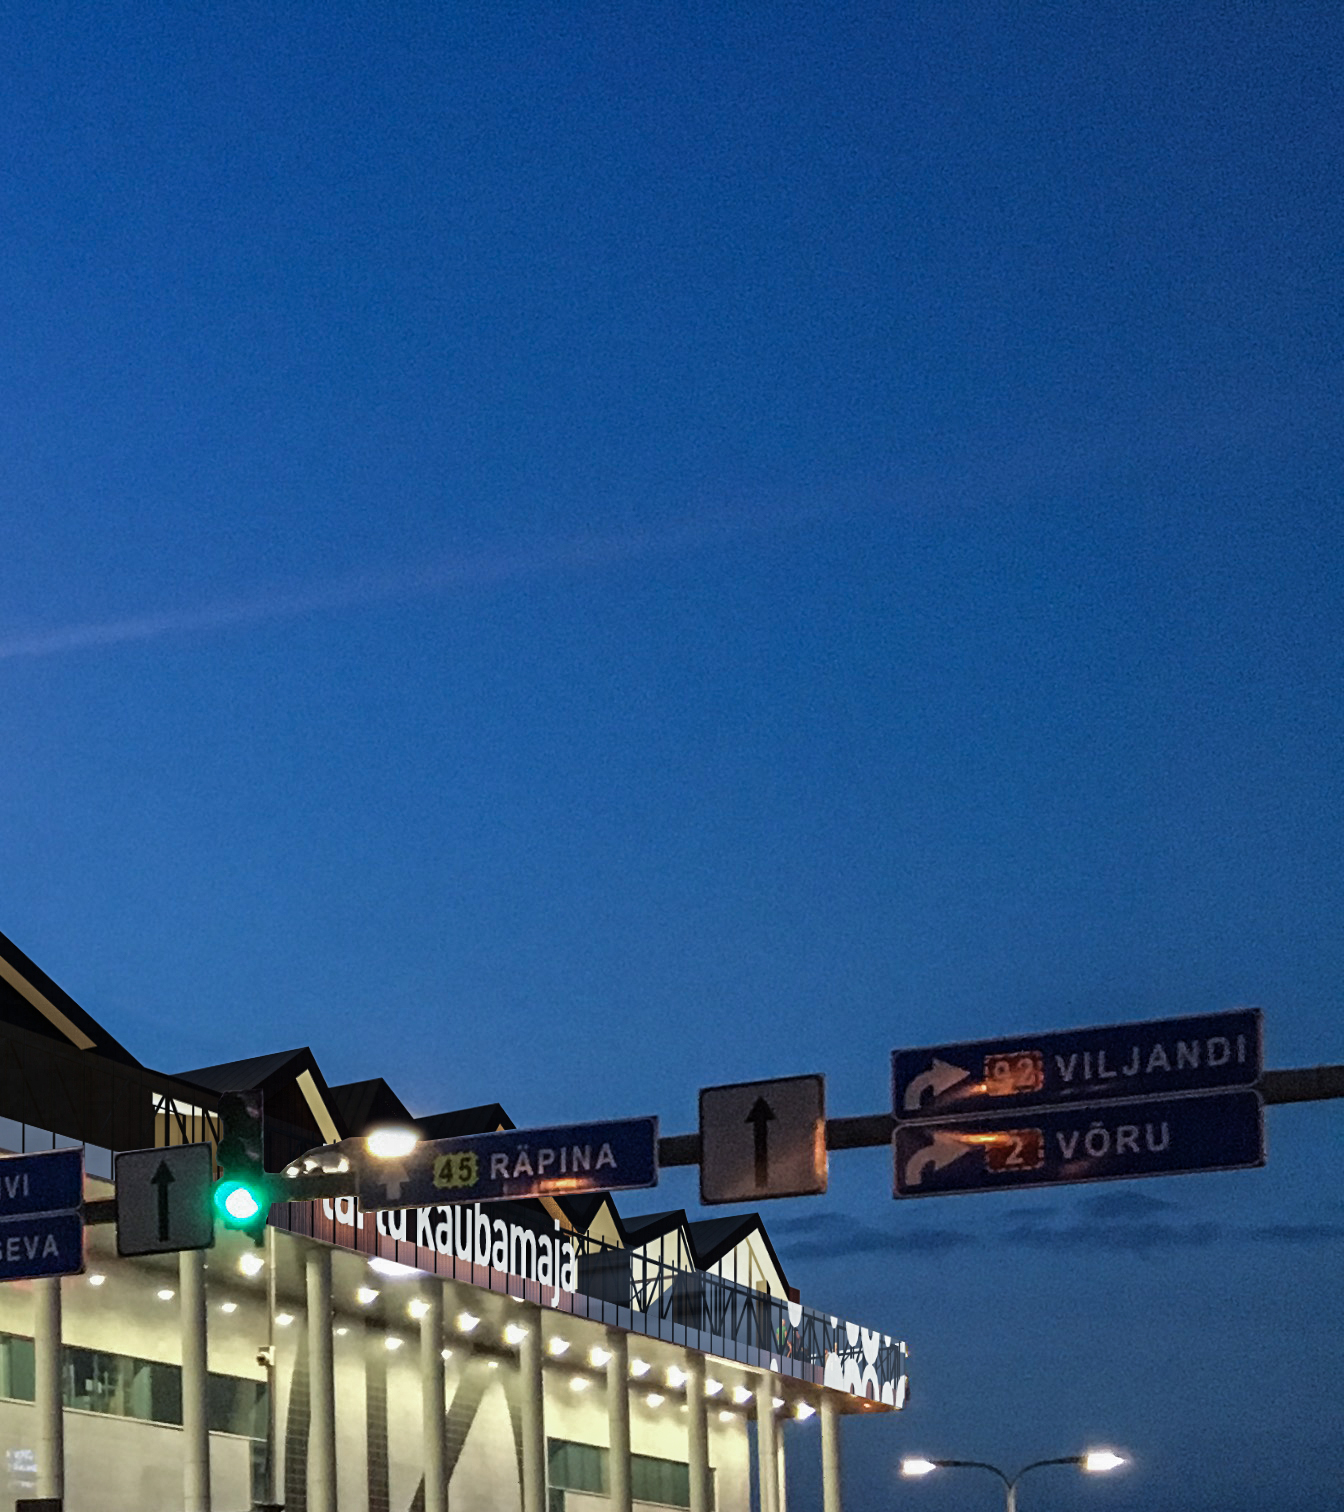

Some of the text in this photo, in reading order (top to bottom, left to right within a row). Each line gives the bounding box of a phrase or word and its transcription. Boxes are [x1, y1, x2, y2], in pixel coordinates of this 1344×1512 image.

[1055, 1034, 1247, 1082] VILJANDI
[438, 1142, 617, 1183] 45 RÄPINA
[1005, 1121, 1170, 1165] 2 VÕRU
[416, 1203, 576, 1308] kaubamaja
